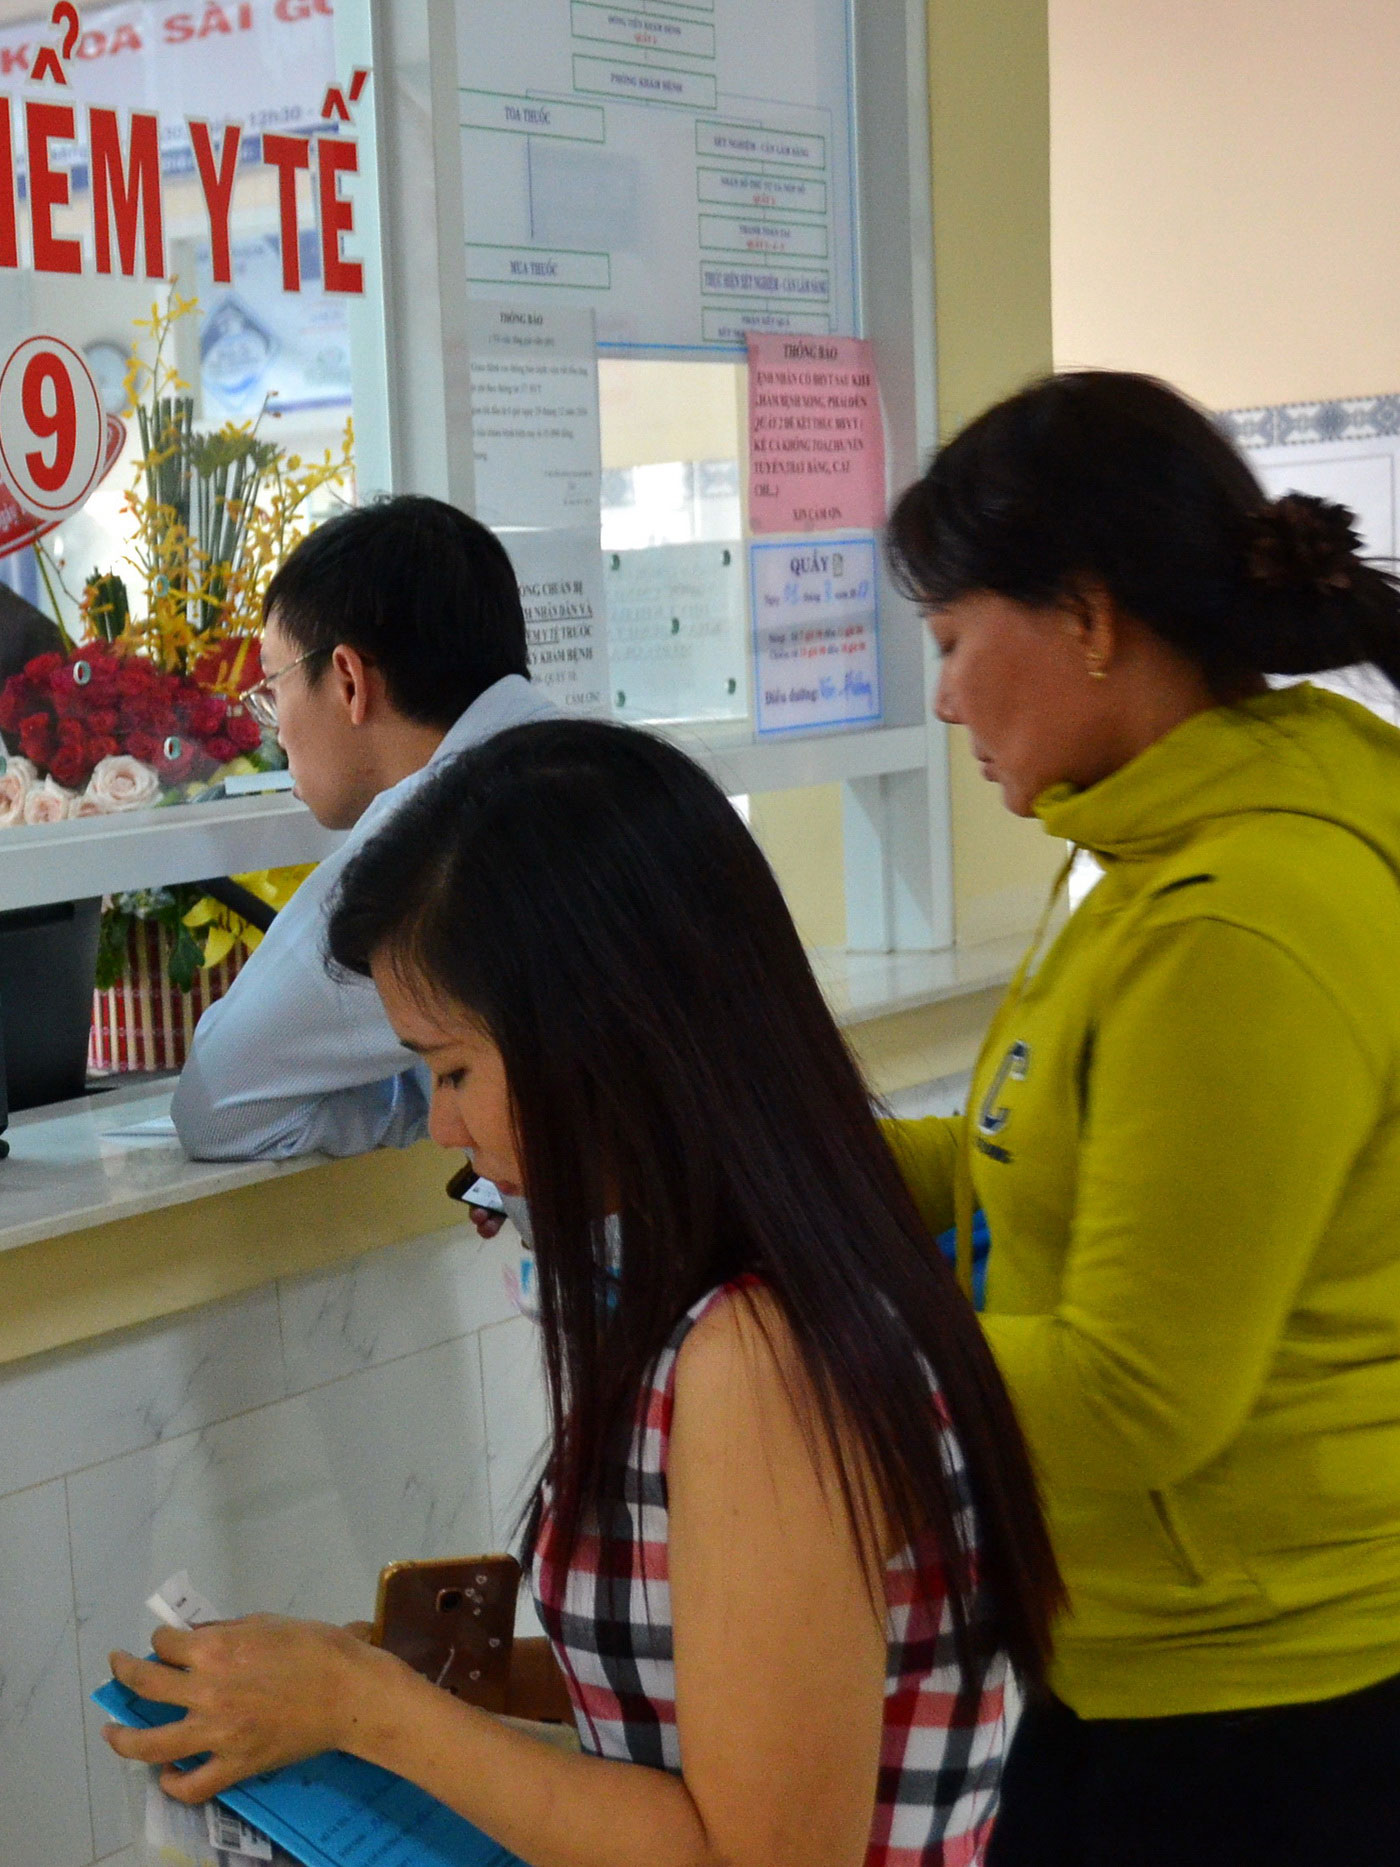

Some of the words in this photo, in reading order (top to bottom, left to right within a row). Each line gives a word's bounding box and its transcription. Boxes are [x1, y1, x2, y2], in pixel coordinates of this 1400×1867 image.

[0, 24, 142, 75] KOA
[189, 120, 241, 283] Y
[262, 70, 368, 293] TẾ
[22, 352, 76, 492] 9
